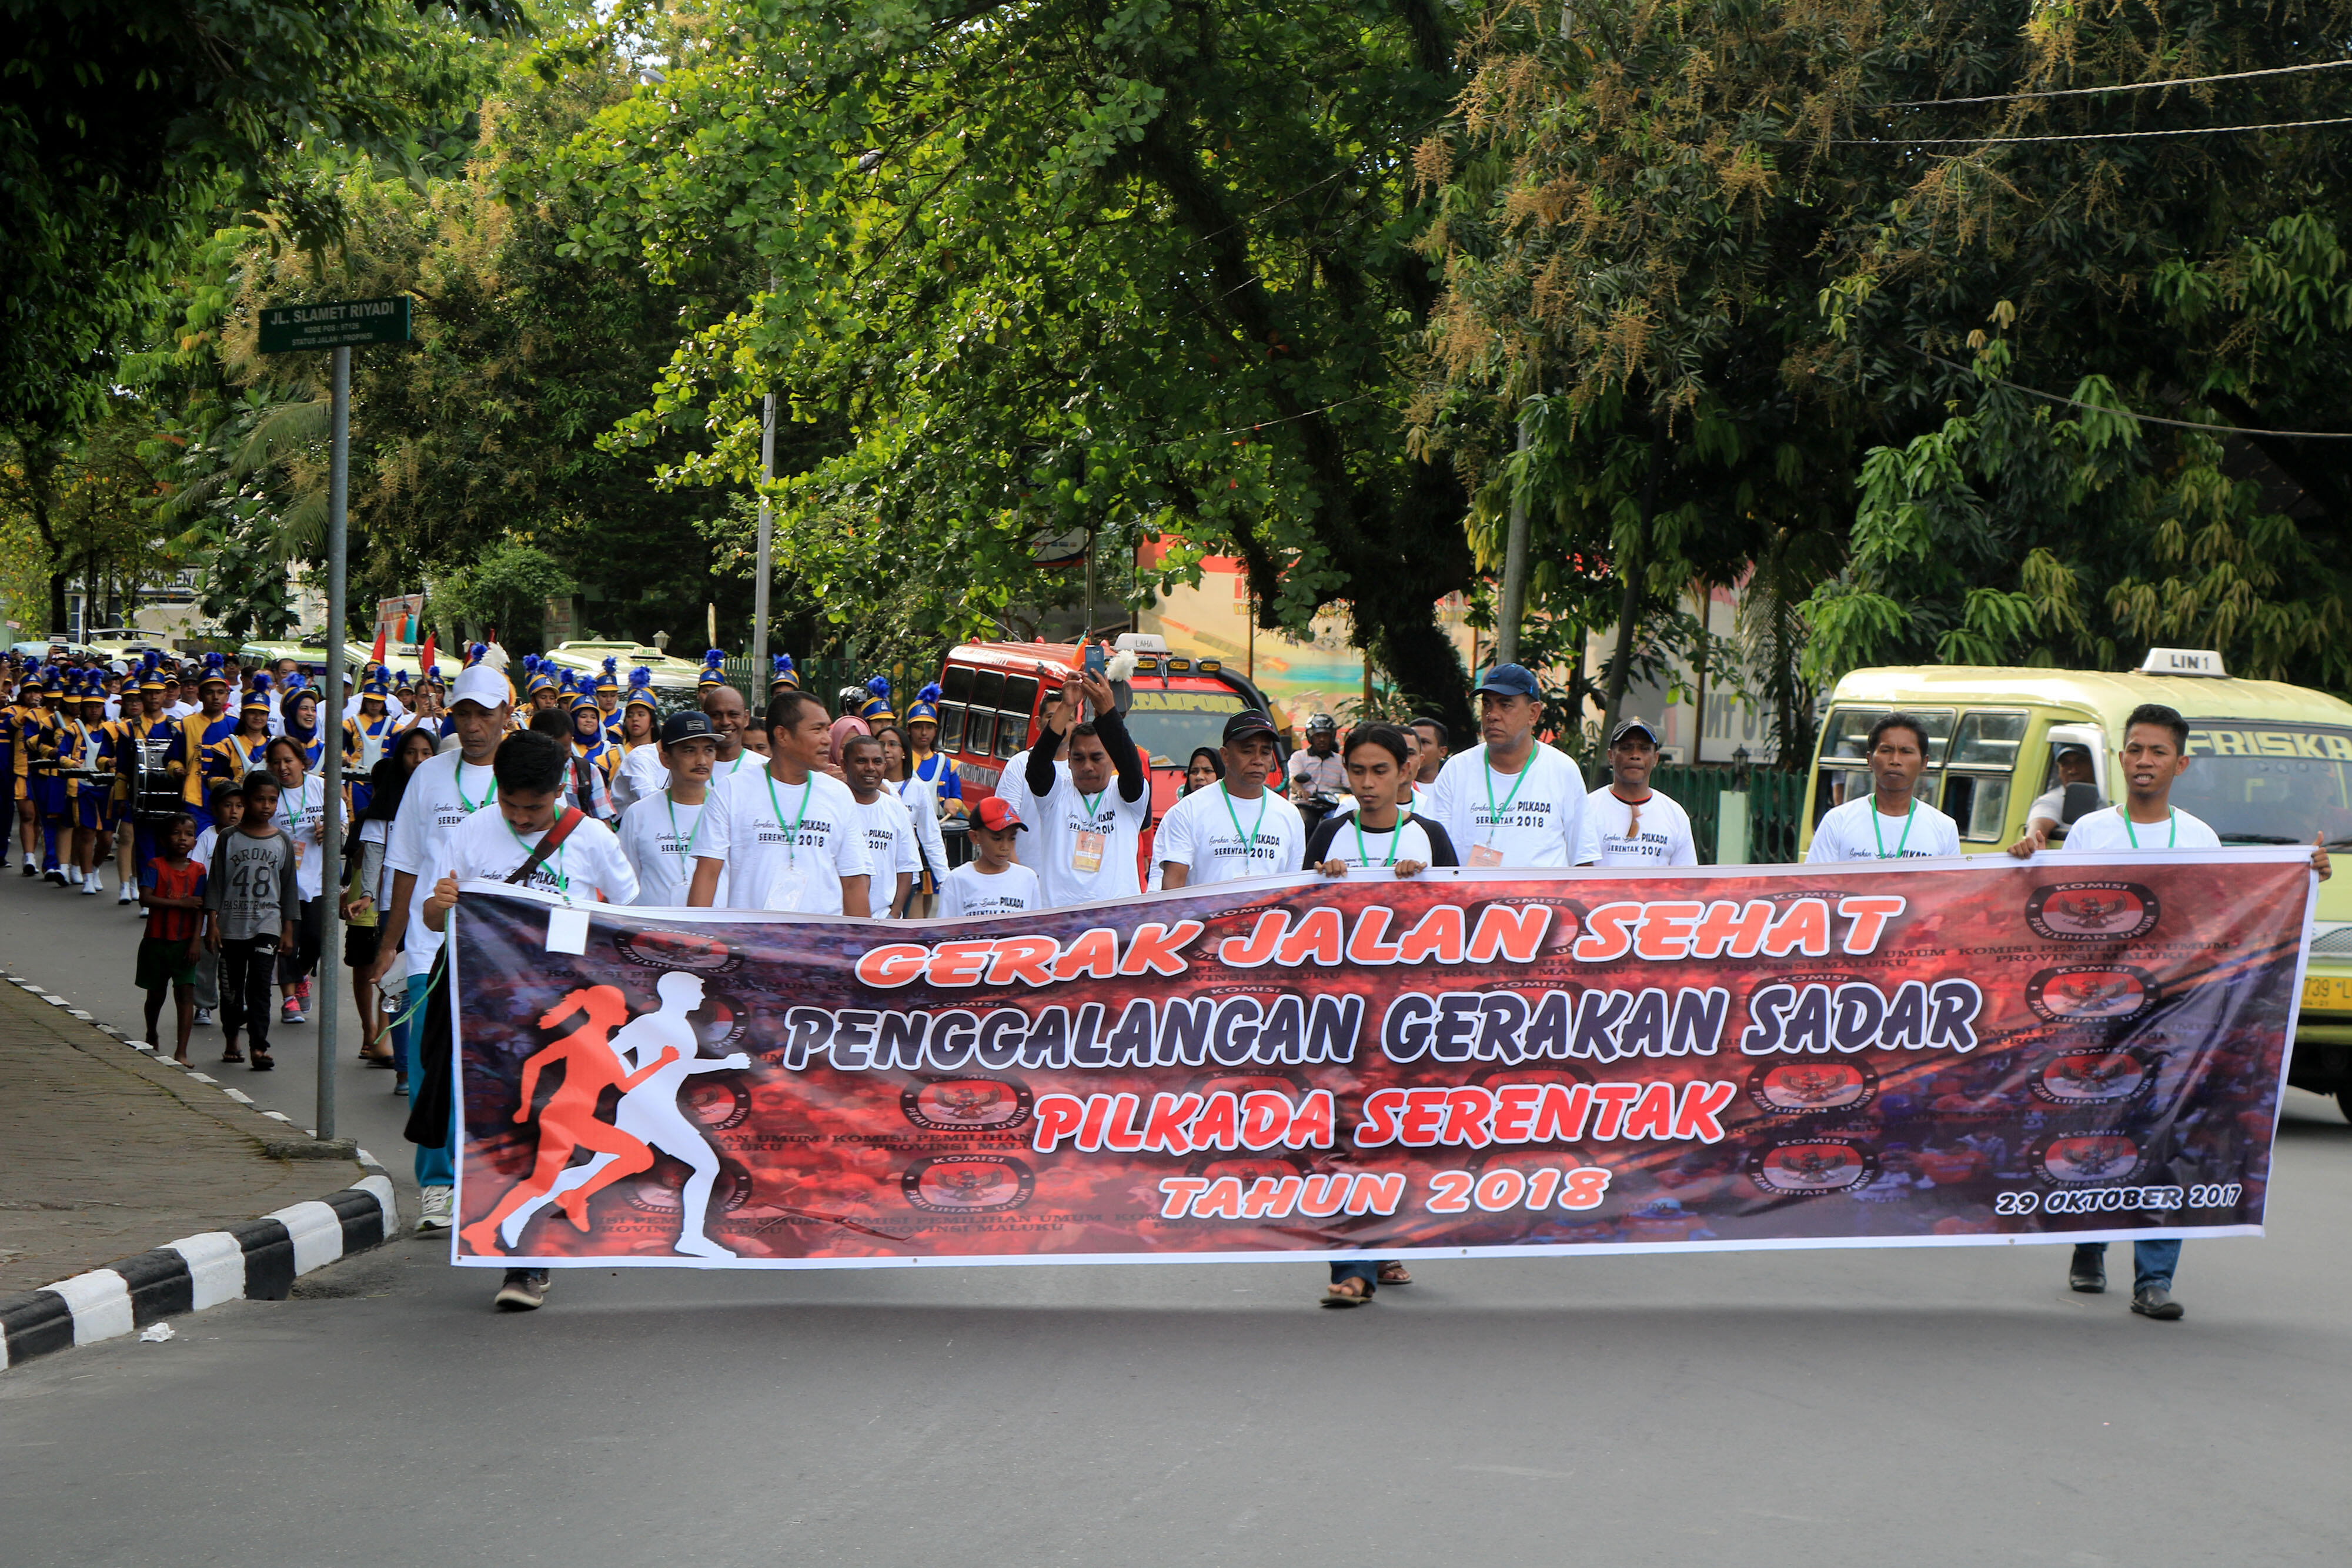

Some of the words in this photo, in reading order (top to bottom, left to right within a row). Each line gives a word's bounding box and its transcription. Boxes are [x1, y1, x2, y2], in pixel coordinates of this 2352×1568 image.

[270, 311, 289, 325] JL.
[293, 306, 346, 323] SLAMET
[350, 301, 395, 318] RIYADI
[304, 325, 321, 333] KODE
[323, 324, 336, 332] POS
[292, 337, 315, 346] STATUS
[317, 335, 337, 344] JALAN
[343, 333, 373, 342] PROPINSI
[2171, 654, 2199, 669] LIN
[2204, 657, 2209, 670] 1
[1517, 801, 1551, 814] PILKADA
[799, 819, 831, 834] PILKADA
[1476, 816, 1514, 825] SERENTAK
[1517, 816, 1544, 828] 2018
[799, 835, 824, 847] 2018
[868, 830, 893, 841] PILKADA
[1641, 833, 1668, 845] PILKADA
[1214, 847, 1247, 855] SERENTAK
[1250, 848, 1275, 858] 2018
[1642, 845, 1662, 857] 2018
[230, 848, 278, 869] BRONX
[232, 865, 270, 898] 48
[2055, 882, 2129, 892] KOMISI
[1491, 896, 1563, 906] KOMISI
[1773, 891, 1845, 901] KOMISI
[1000, 897, 1024, 909] PILKADA
[1208, 904, 1280, 920] KOMISI
[2029, 917, 2107, 941] PEMILIHAN
[2121, 914, 2156, 940] UMUM
[855, 919, 1205, 988] GERAK
[1220, 904, 1552, 968] JALAN
[1573, 895, 1906, 962] SEHAT
[1883, 948, 1947, 958] UMUM
[1958, 946, 2033, 955] KOMISI
[2040, 942, 2157, 952] PEMILIHAN
[2165, 941, 2230, 951] UMUM
[1996, 953, 2094, 962] PROVINSI
[1715, 962, 1818, 973] PROVINSI
[1824, 958, 1909, 968] MALUKU
[2057, 964, 2129, 974] KOMISI
[1255, 971, 1341, 981] MALUKU
[1431, 969, 1528, 978] PROVINSI
[1538, 967, 1625, 976] MALUKU
[1778, 973, 1849, 984] KOMISI
[1210, 985, 1282, 995] KOMISI
[1492, 979, 1566, 991] KOMISI
[2030, 999, 2109, 1024] PEMILIHAN
[783, 993, 1365, 1071] PENGGALANGAN
[1381, 987, 1730, 1066] GERAKAN
[1740, 978, 1982, 1055] SADAR
[1977, 1027, 2033, 1037] OMISI
[2058, 1047, 2129, 1057] KOMISI
[2032, 1081, 2109, 1106] PEMILIHAN
[1750, 1090, 1828, 1115] PEMILIHAN
[1839, 1088, 1876, 1112] UMUM
[905, 1107, 983, 1131] PEMILIHAN
[994, 1105, 1030, 1129] UMUM
[1033, 1090, 1334, 1156] PILKADA
[1354, 1080, 1737, 1149] SERENTAK
[756, 1134, 820, 1142] UMUM
[833, 1134, 910, 1143] KOMISI
[916, 1132, 1031, 1142] PEMILIHAN
[2059, 1129, 2126, 1138] KOMISI
[710, 1144, 782, 1152] ALUKU
[871, 1143, 971, 1152] PROVINSI
[977, 1142, 1034, 1151] MALU
[1776, 1138, 1849, 1147] KOMISI
[932, 1155, 1005, 1165] KOMISI
[1750, 1172, 1829, 1196] PEMILIHAN
[1839, 1168, 1875, 1193] UMUM
[1159, 1172, 1406, 1219] TAHUN
[1426, 1167, 1612, 1213] 2018
[1996, 1191, 2040, 1215] 29
[2044, 1185, 2182, 1215] OKTOBER
[2188, 1183, 2241, 1209] 2017
[907, 1189, 984, 1213] PEMILIHAN
[995, 1188, 1031, 1212] UMUM
[757, 1217, 821, 1226] UMUM
[833, 1216, 910, 1226] KOMISI
[916, 1215, 1032, 1225] PEMILIHAN
[1038, 1212, 1102, 1222] UMUM
[871, 1224, 971, 1234] PROVINSI
[978, 1222, 1064, 1232] MALUKU
